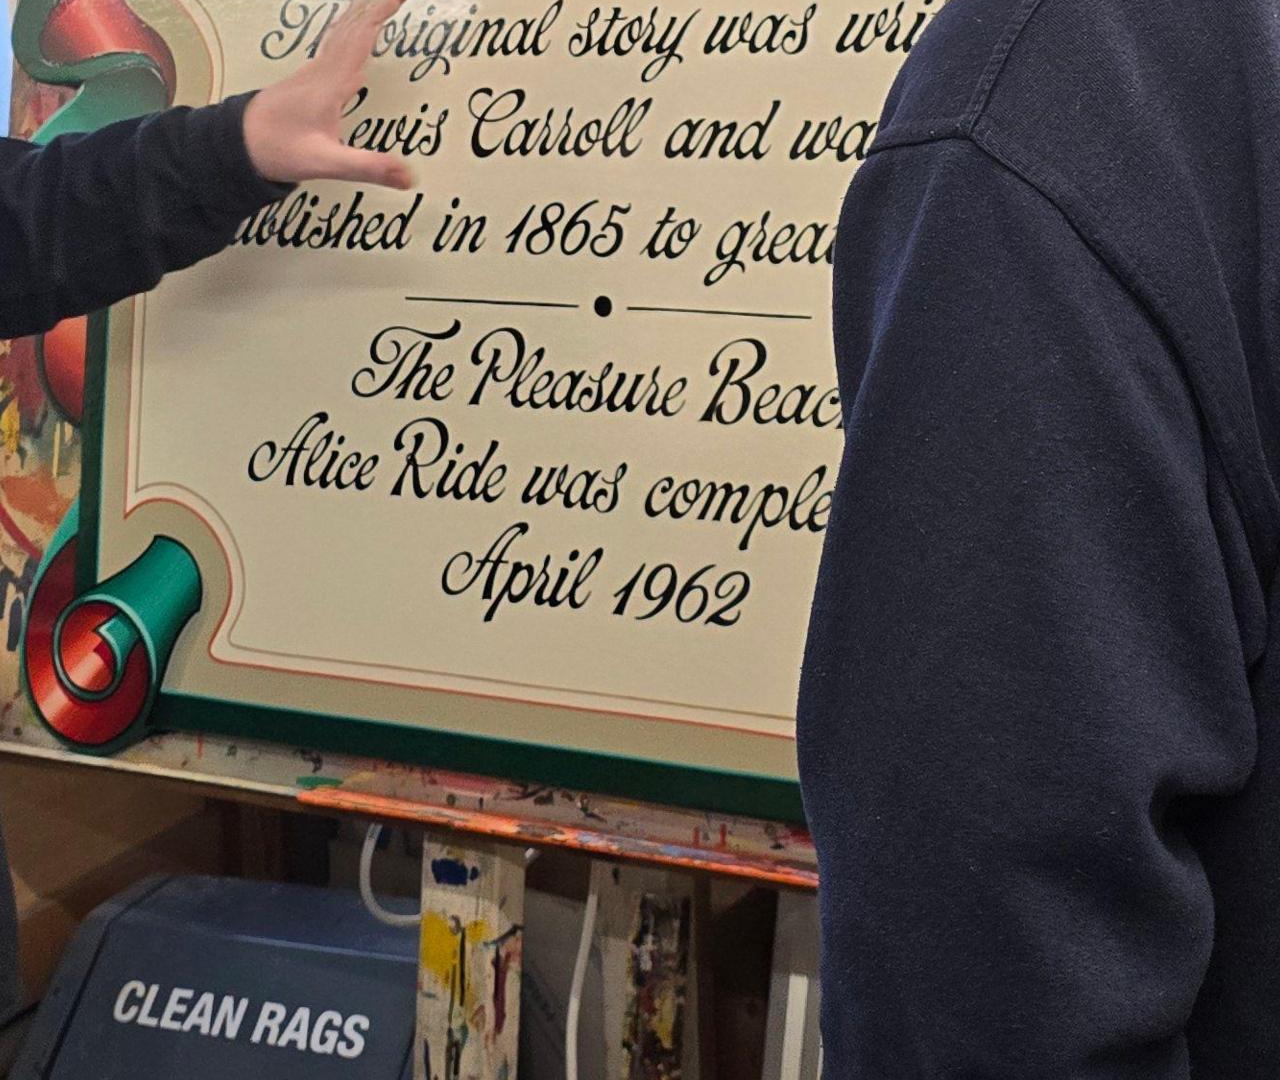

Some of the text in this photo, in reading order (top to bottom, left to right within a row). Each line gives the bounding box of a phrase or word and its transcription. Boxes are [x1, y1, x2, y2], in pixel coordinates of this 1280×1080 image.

[568, 6, 701, 82] story
[703, 3, 817, 55] was
[468, 87, 653, 158] Carroll
[663, 99, 781, 160] and
[788, 115, 878, 162] wa
[233, 190, 423, 252] ublished
[432, 197, 487, 254] in
[505, 199, 632, 258] 1865
[640, 206, 702, 260] to
[351, 318, 846, 431] The Pleasure Beac
[247, 411, 379, 491] Alice
[390, 417, 507, 503] Ride
[521, 462, 628, 513] was
[441, 522, 751, 627] April 1962
[112, 980, 370, 1059] CLEAN RAGS
